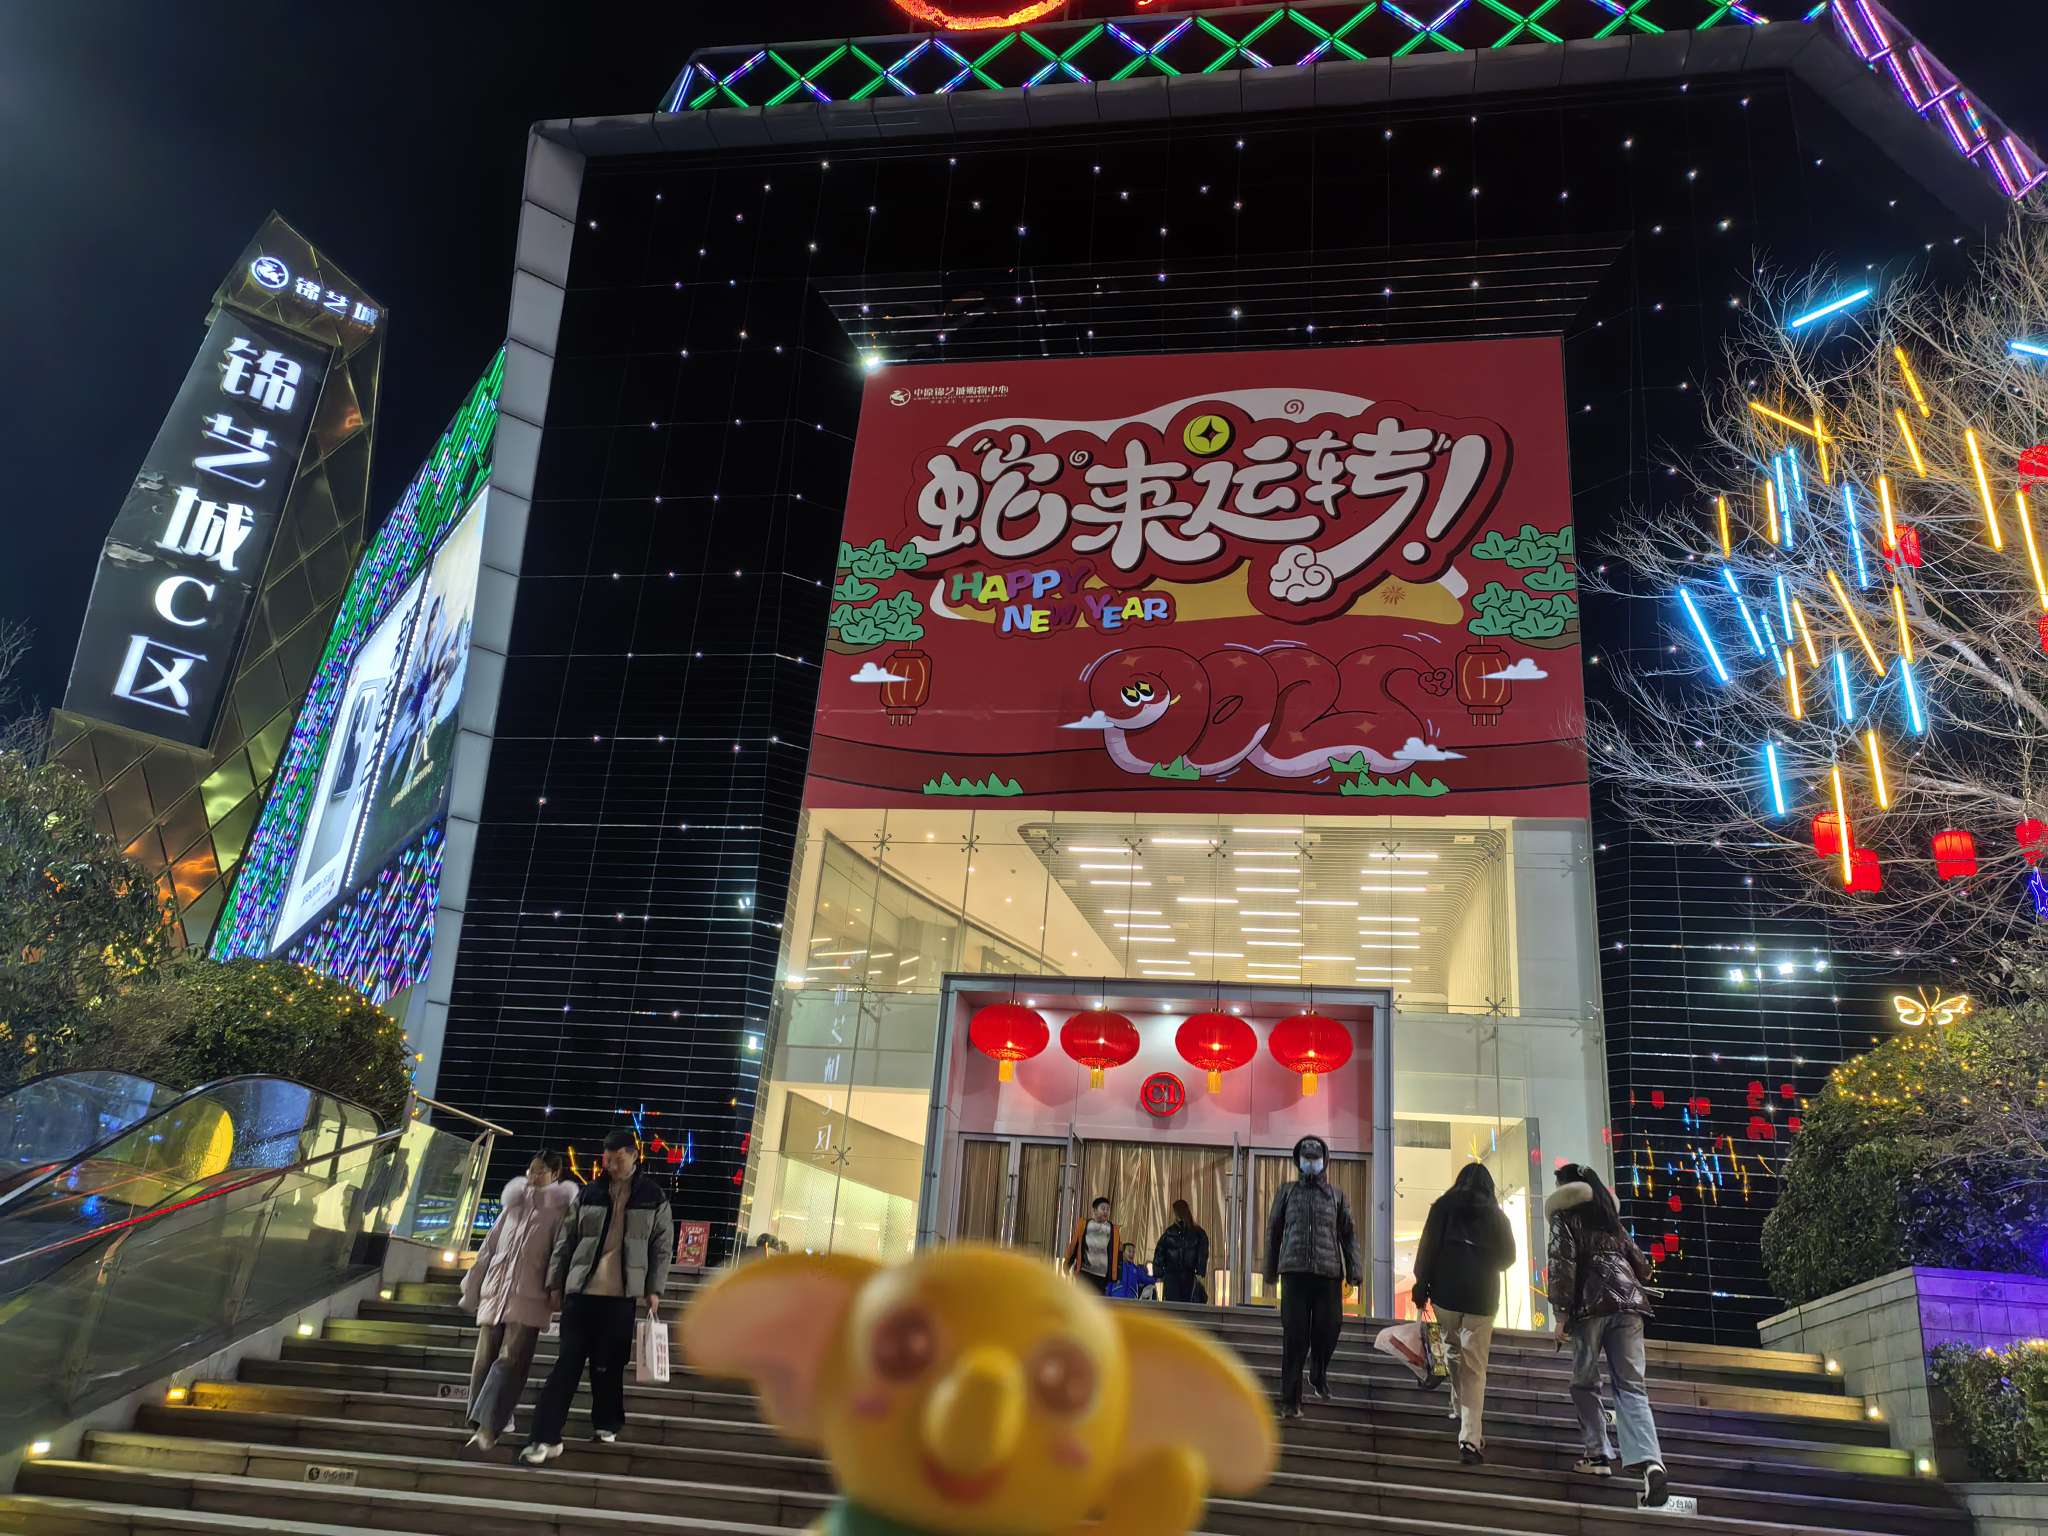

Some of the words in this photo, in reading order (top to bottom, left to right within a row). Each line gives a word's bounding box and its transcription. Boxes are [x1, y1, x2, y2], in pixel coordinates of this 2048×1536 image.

[112, 336, 303, 728] 锦艺城C区
[950, 564, 1089, 604] HAPPY
[1001, 603, 1078, 633] NEW
[1085, 594, 1168, 629] YEAR
